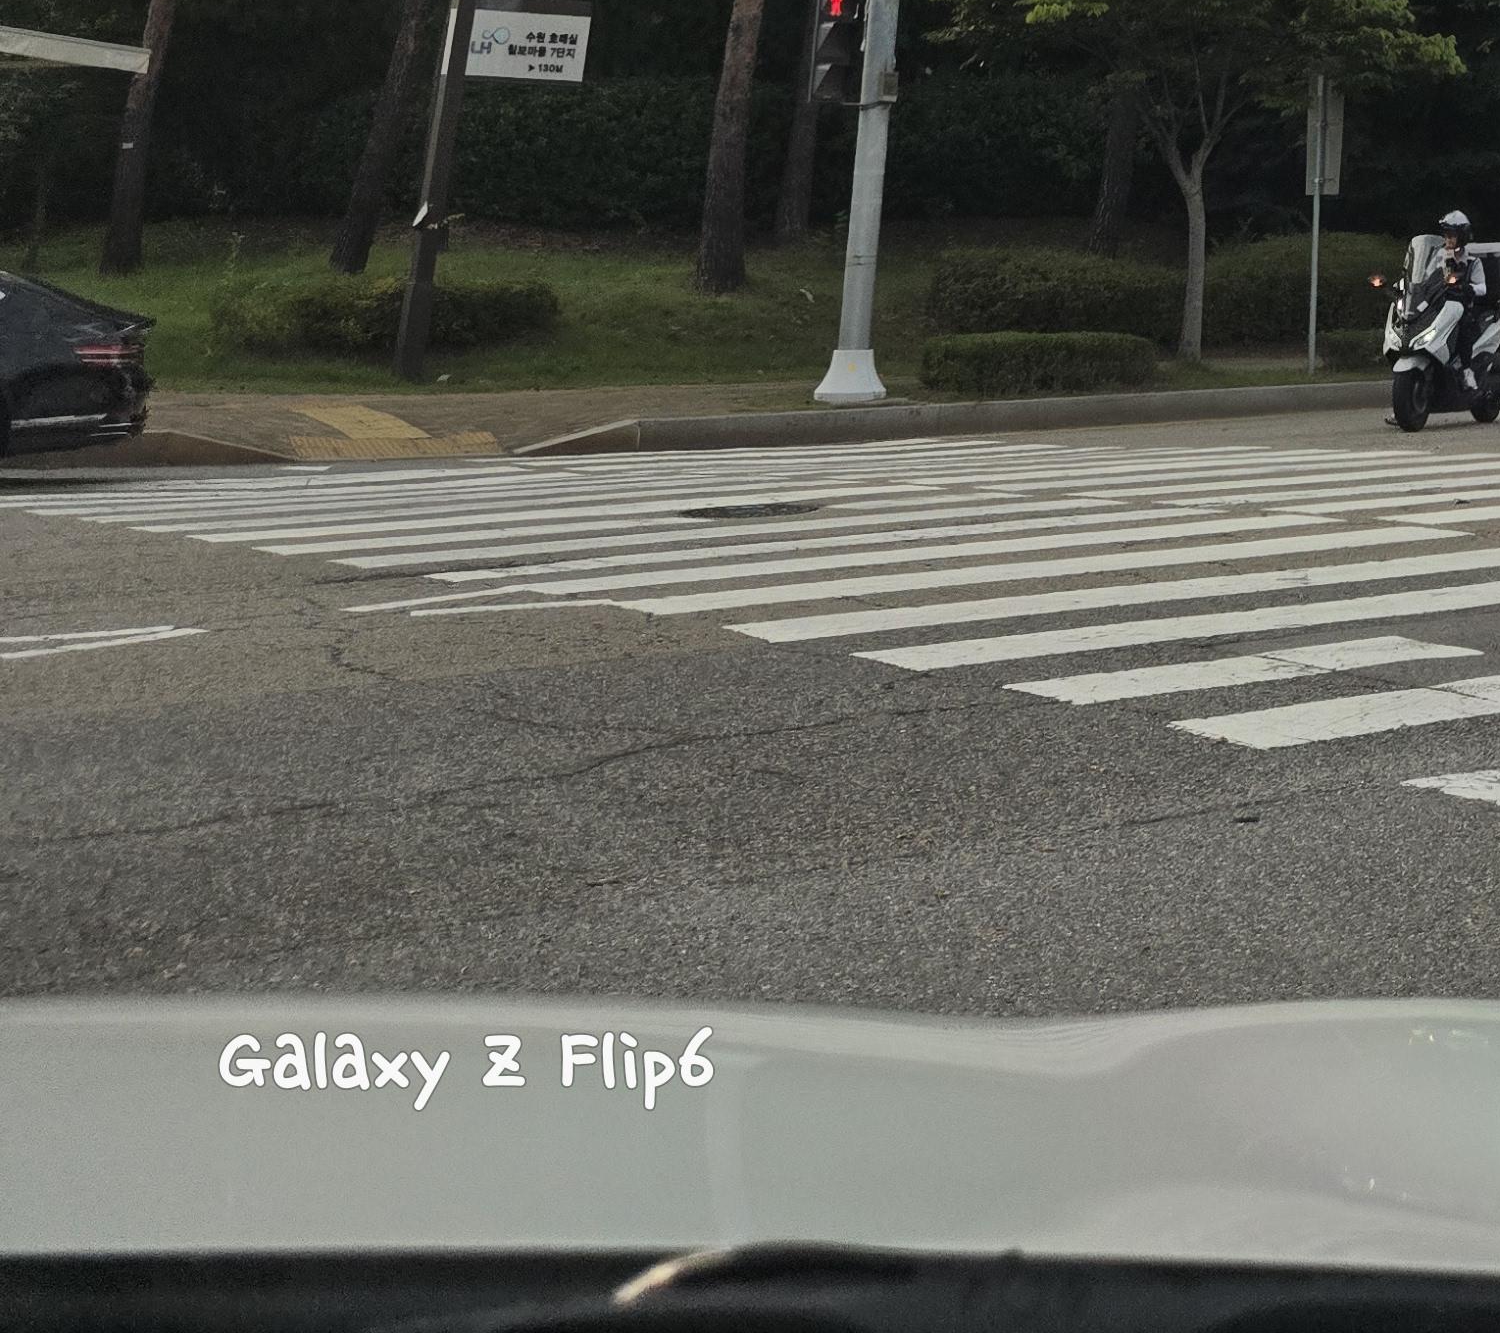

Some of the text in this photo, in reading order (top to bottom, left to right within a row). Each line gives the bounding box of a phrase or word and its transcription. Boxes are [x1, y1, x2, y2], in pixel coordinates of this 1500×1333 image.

[525, 31, 546, 44] 수원
[470, 40, 493, 55] LH
[508, 44, 577, 60] 칠보마을 7단지
[538, 63, 564, 74] 130M
